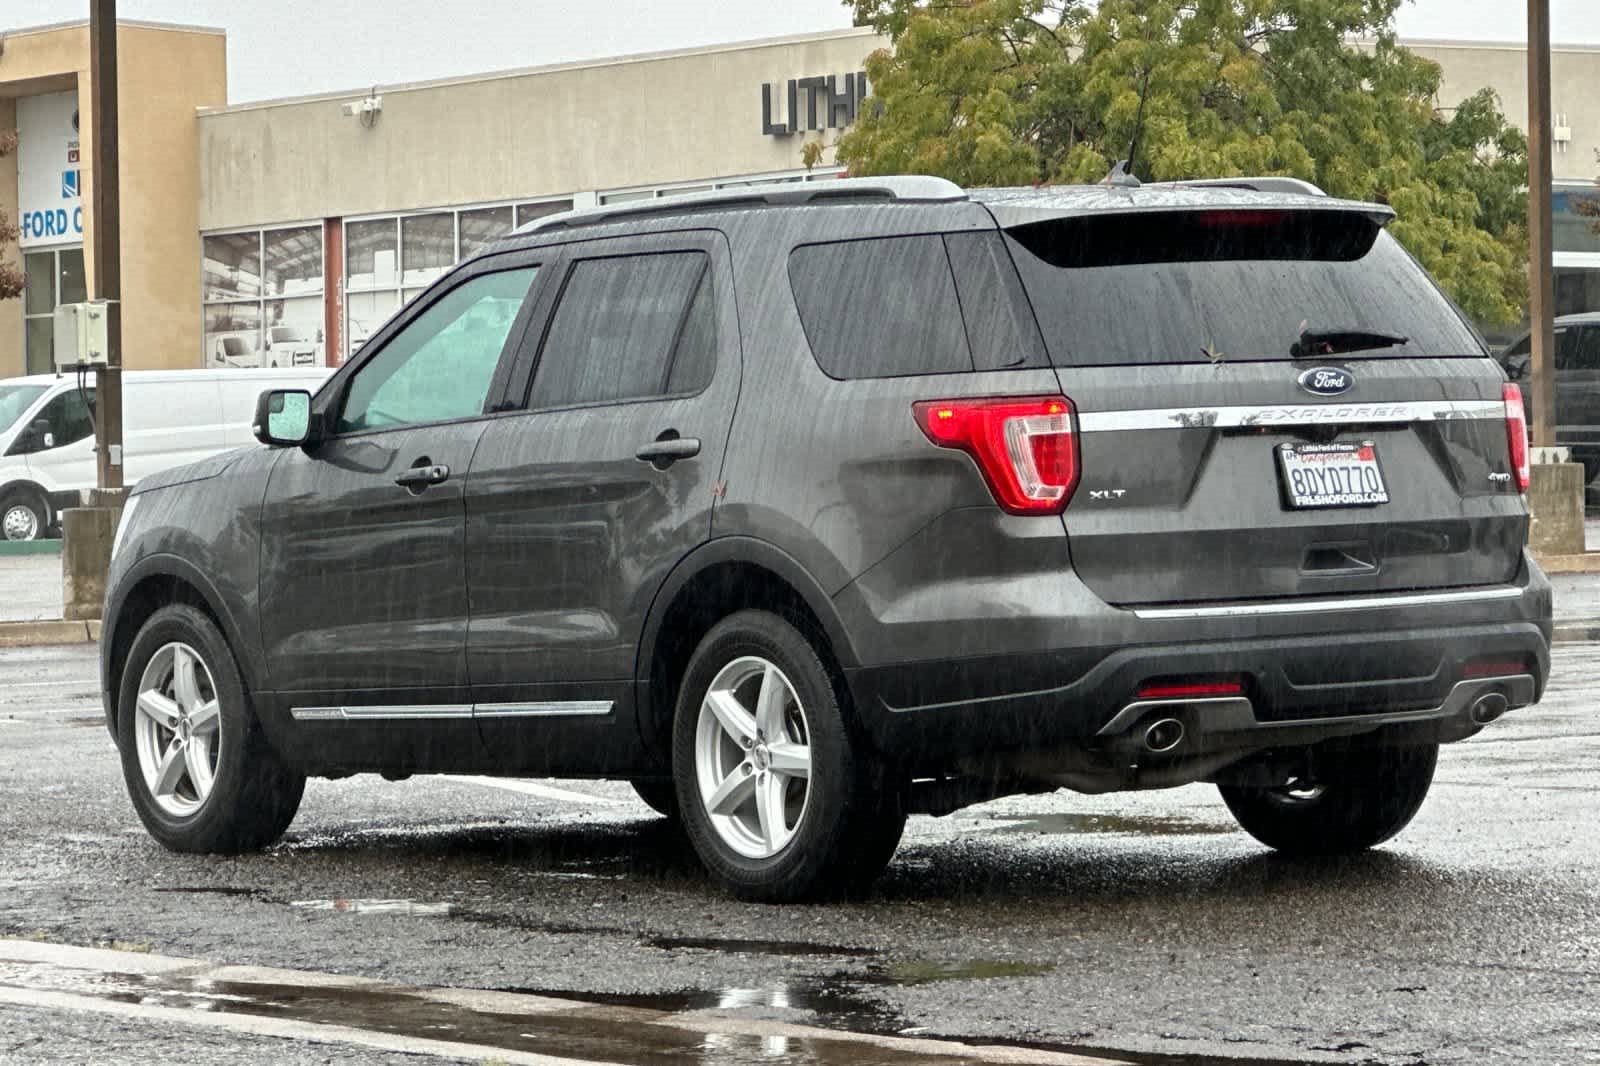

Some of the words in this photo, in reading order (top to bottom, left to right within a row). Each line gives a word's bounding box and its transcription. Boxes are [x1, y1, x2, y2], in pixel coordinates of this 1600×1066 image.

[23, 208, 67, 238] FORD
[1314, 371, 1345, 388] Ford
[1257, 406, 1409, 421] EXPLORER
[1292, 466, 1379, 496] 8DYD770
[1090, 490, 1126, 500] XLT
